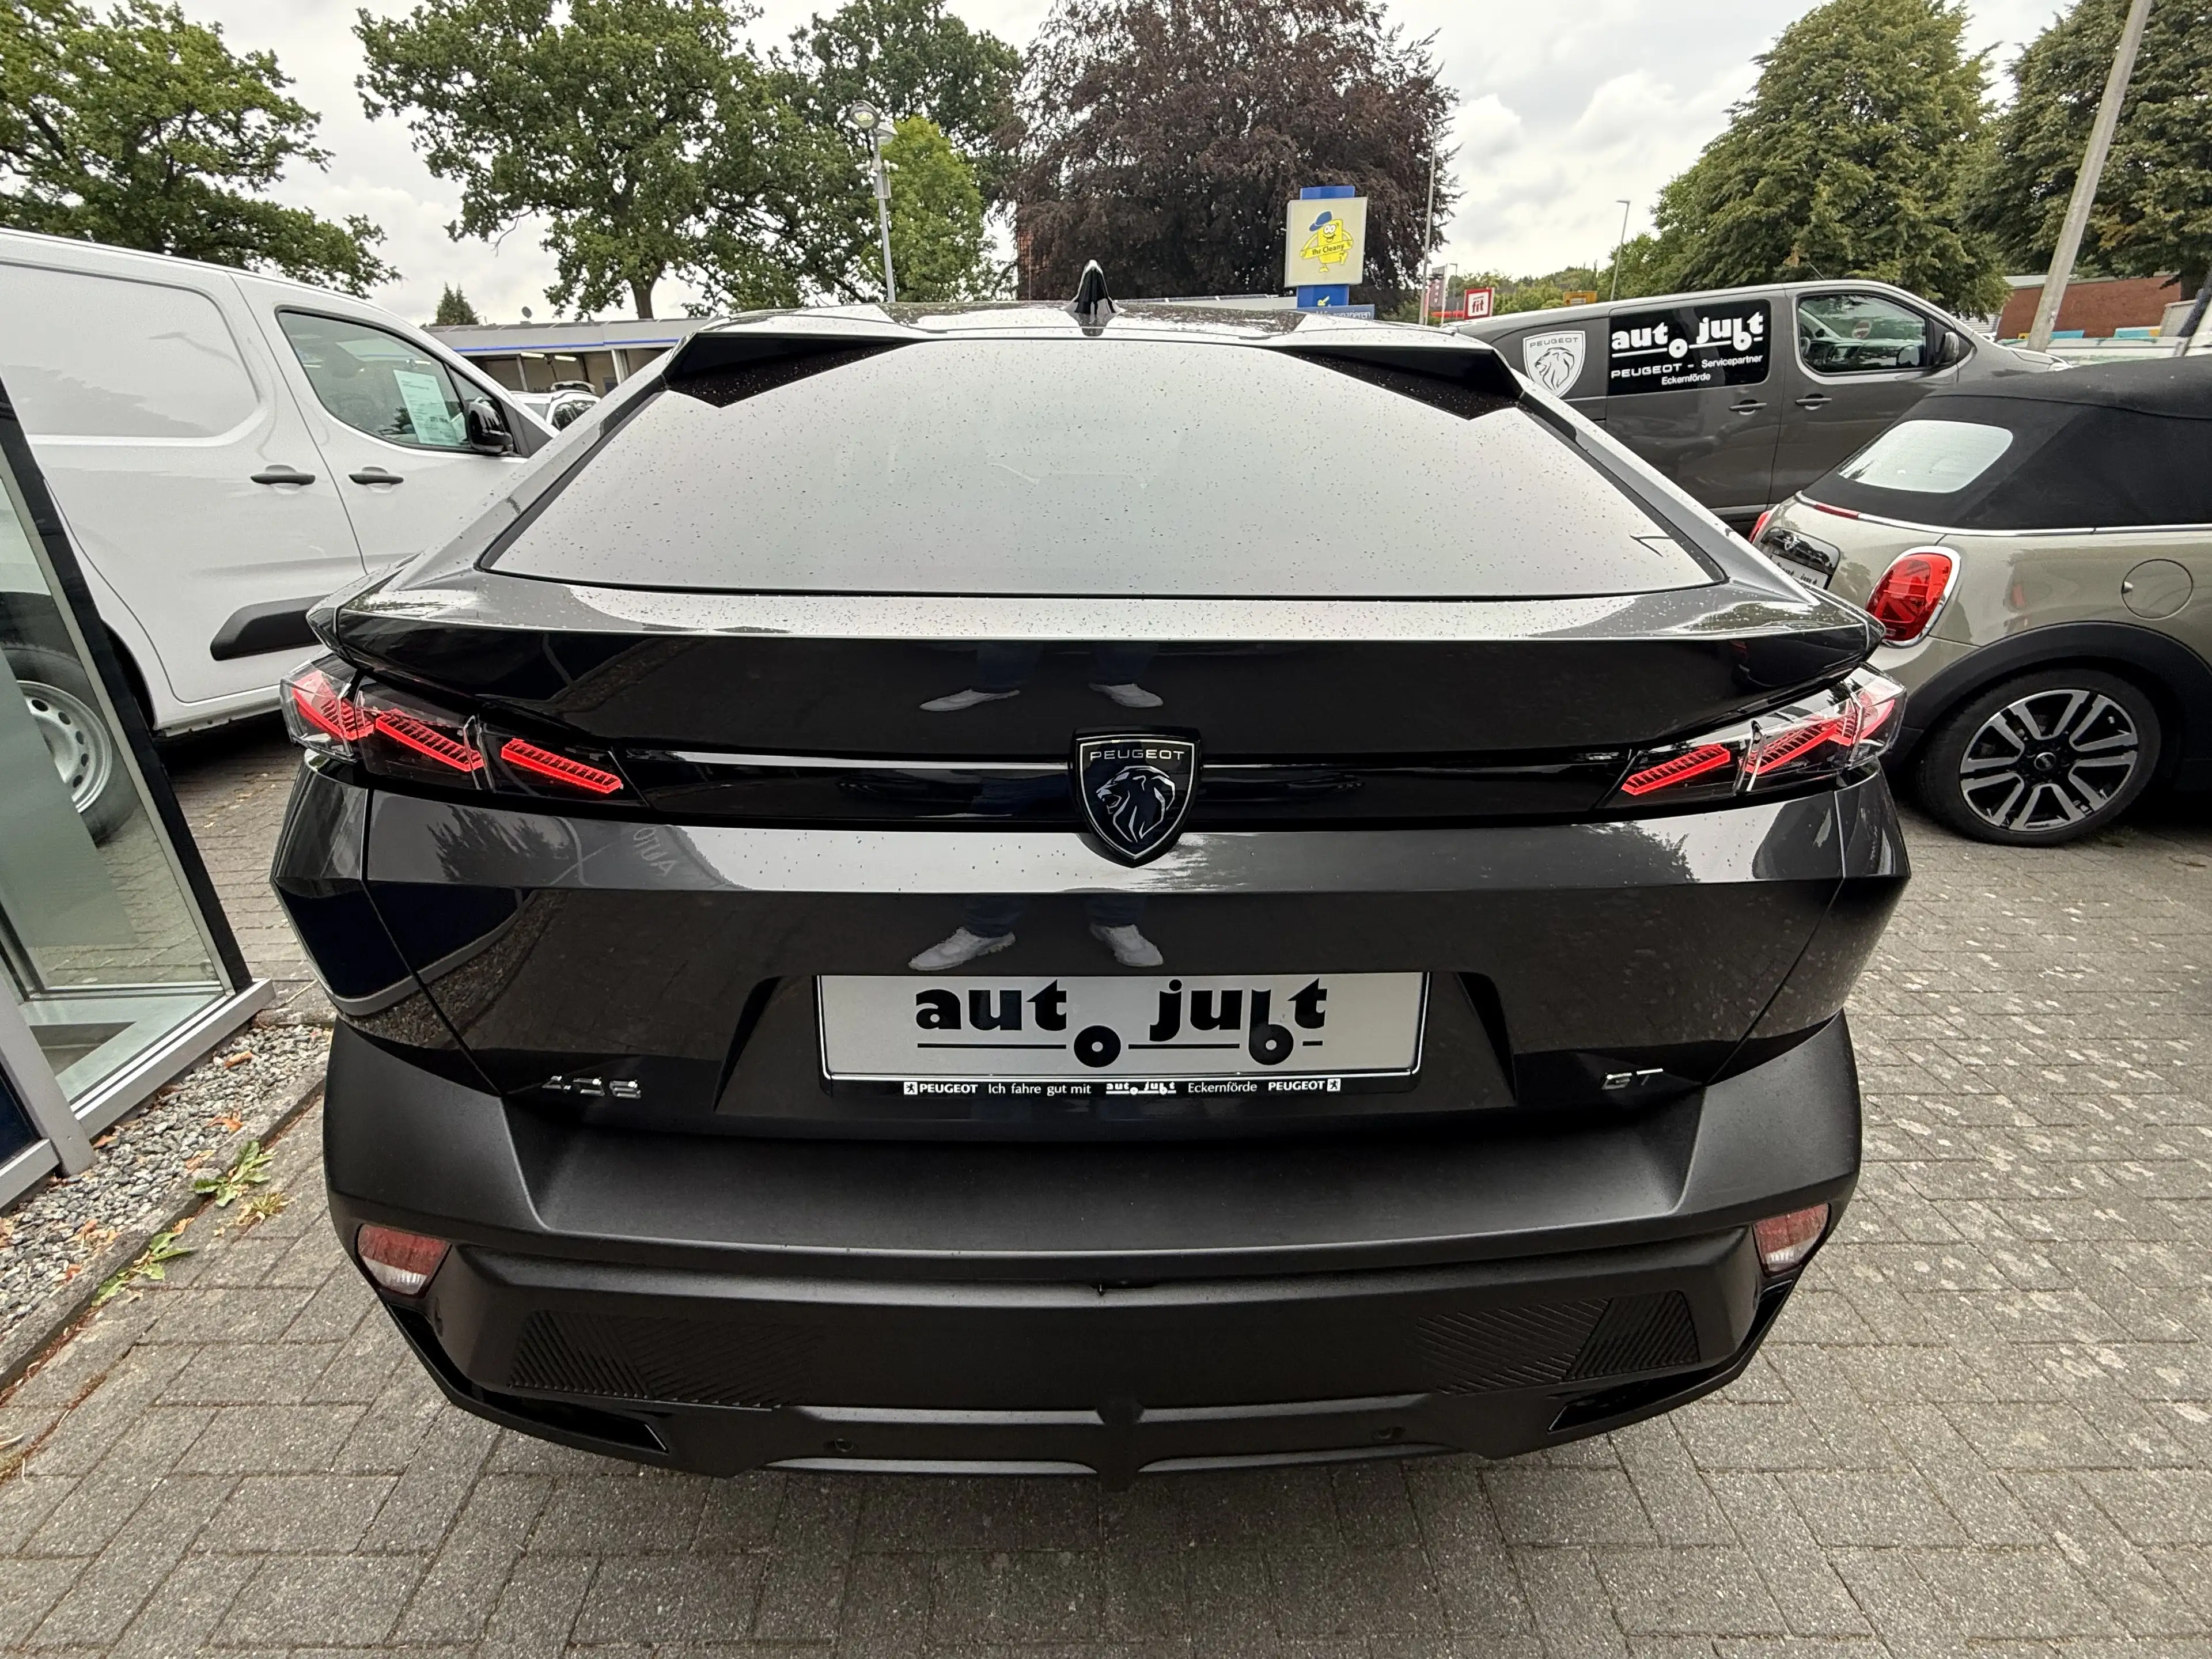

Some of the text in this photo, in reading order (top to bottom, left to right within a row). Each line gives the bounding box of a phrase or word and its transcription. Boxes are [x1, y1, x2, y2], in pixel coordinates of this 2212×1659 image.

[1323, 244, 1344, 253] Cleany
[1472, 299, 1484, 313] fit
[1530, 337, 1578, 348] PEUGEOT
[1611, 363, 1683, 378] PEUGEOT
[1701, 355, 1763, 369] Servicepartner
[1661, 373, 1711, 385] Eckernförde
[1090, 749, 1185, 760] PEUGEOT
[919, 1084, 978, 1093] PEUGEOT
[988, 1083, 1006, 1094] Ich
[1011, 1083, 1041, 1094] fahre
[1047, 1084, 1067, 1096] gut
[1070, 1083, 1092, 1094] mit
[1188, 1081, 1257, 1093] Eckernförde
[1268, 1081, 1325, 1091] PEUGEOT
